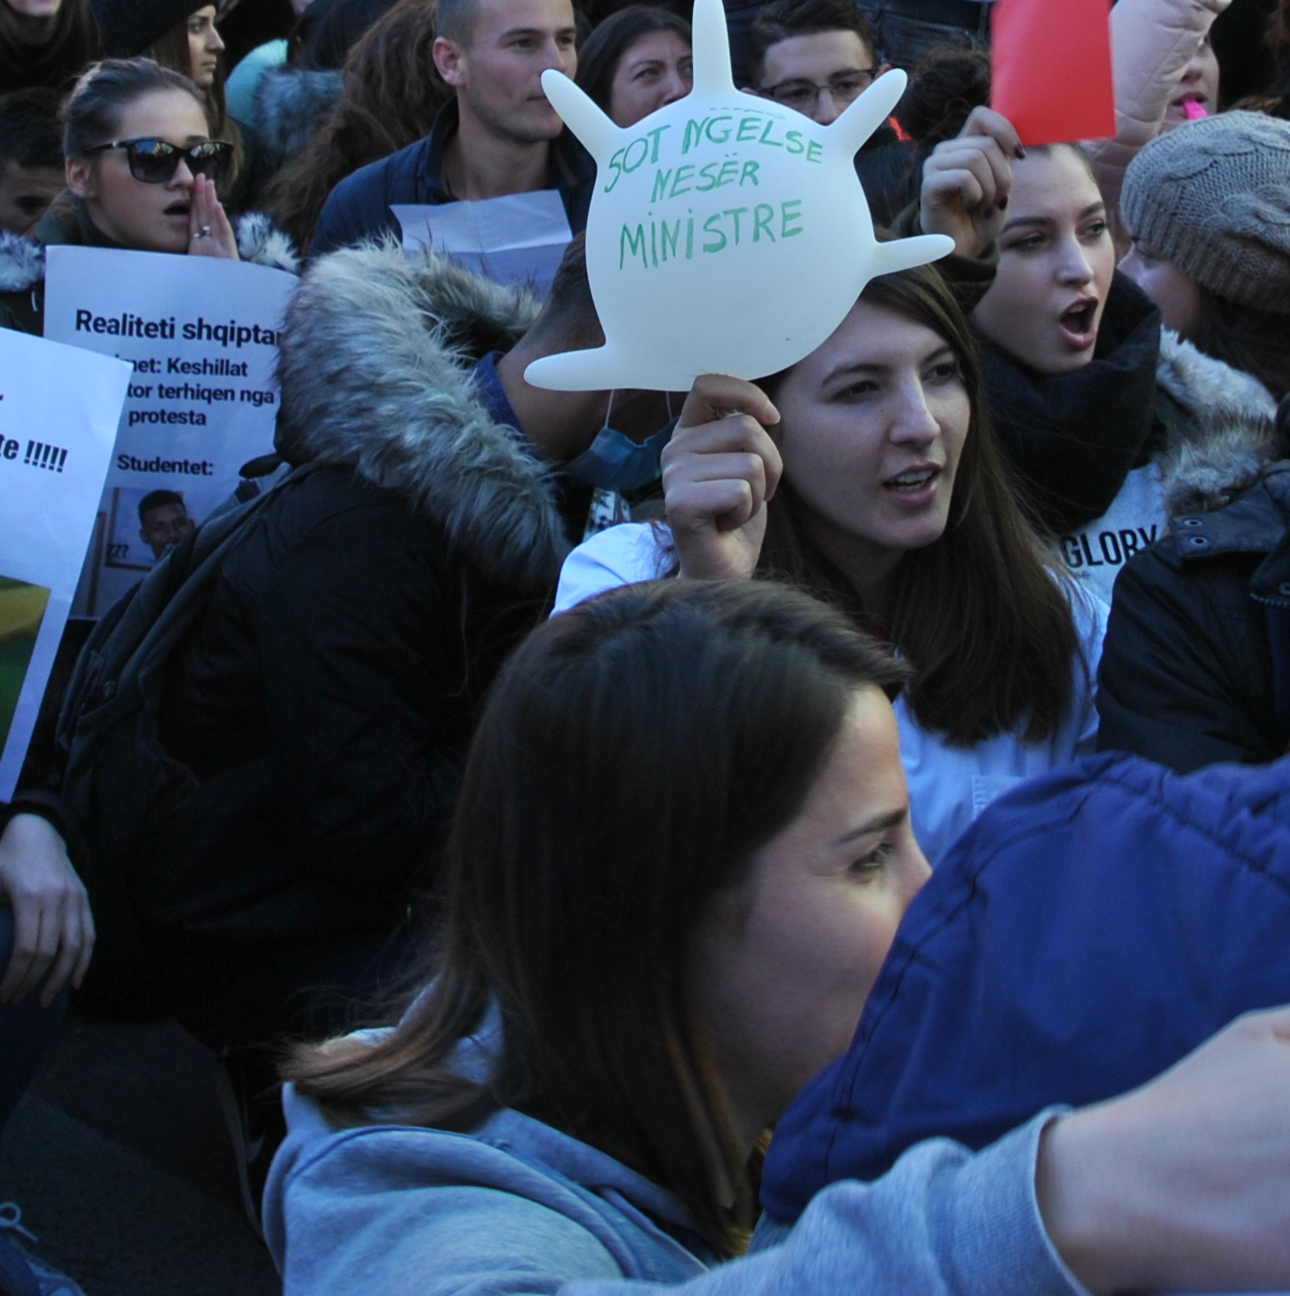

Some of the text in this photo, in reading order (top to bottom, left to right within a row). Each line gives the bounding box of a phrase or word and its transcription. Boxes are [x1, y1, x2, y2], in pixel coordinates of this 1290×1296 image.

[604, 114, 824, 194] SOT NGELSE
[650, 151, 760, 203] NESËR
[75, 309, 176, 340] Realiteti
[166, 357, 248, 377] Keshillat
[158, 382, 236, 405] terhiqen
[240, 389, 275, 407] nga
[128, 409, 207, 427] protesta
[23, 439, 69, 474] !!!!!
[116, 454, 214, 476] Studentet:
[1060, 523, 1157, 568] GLORY
